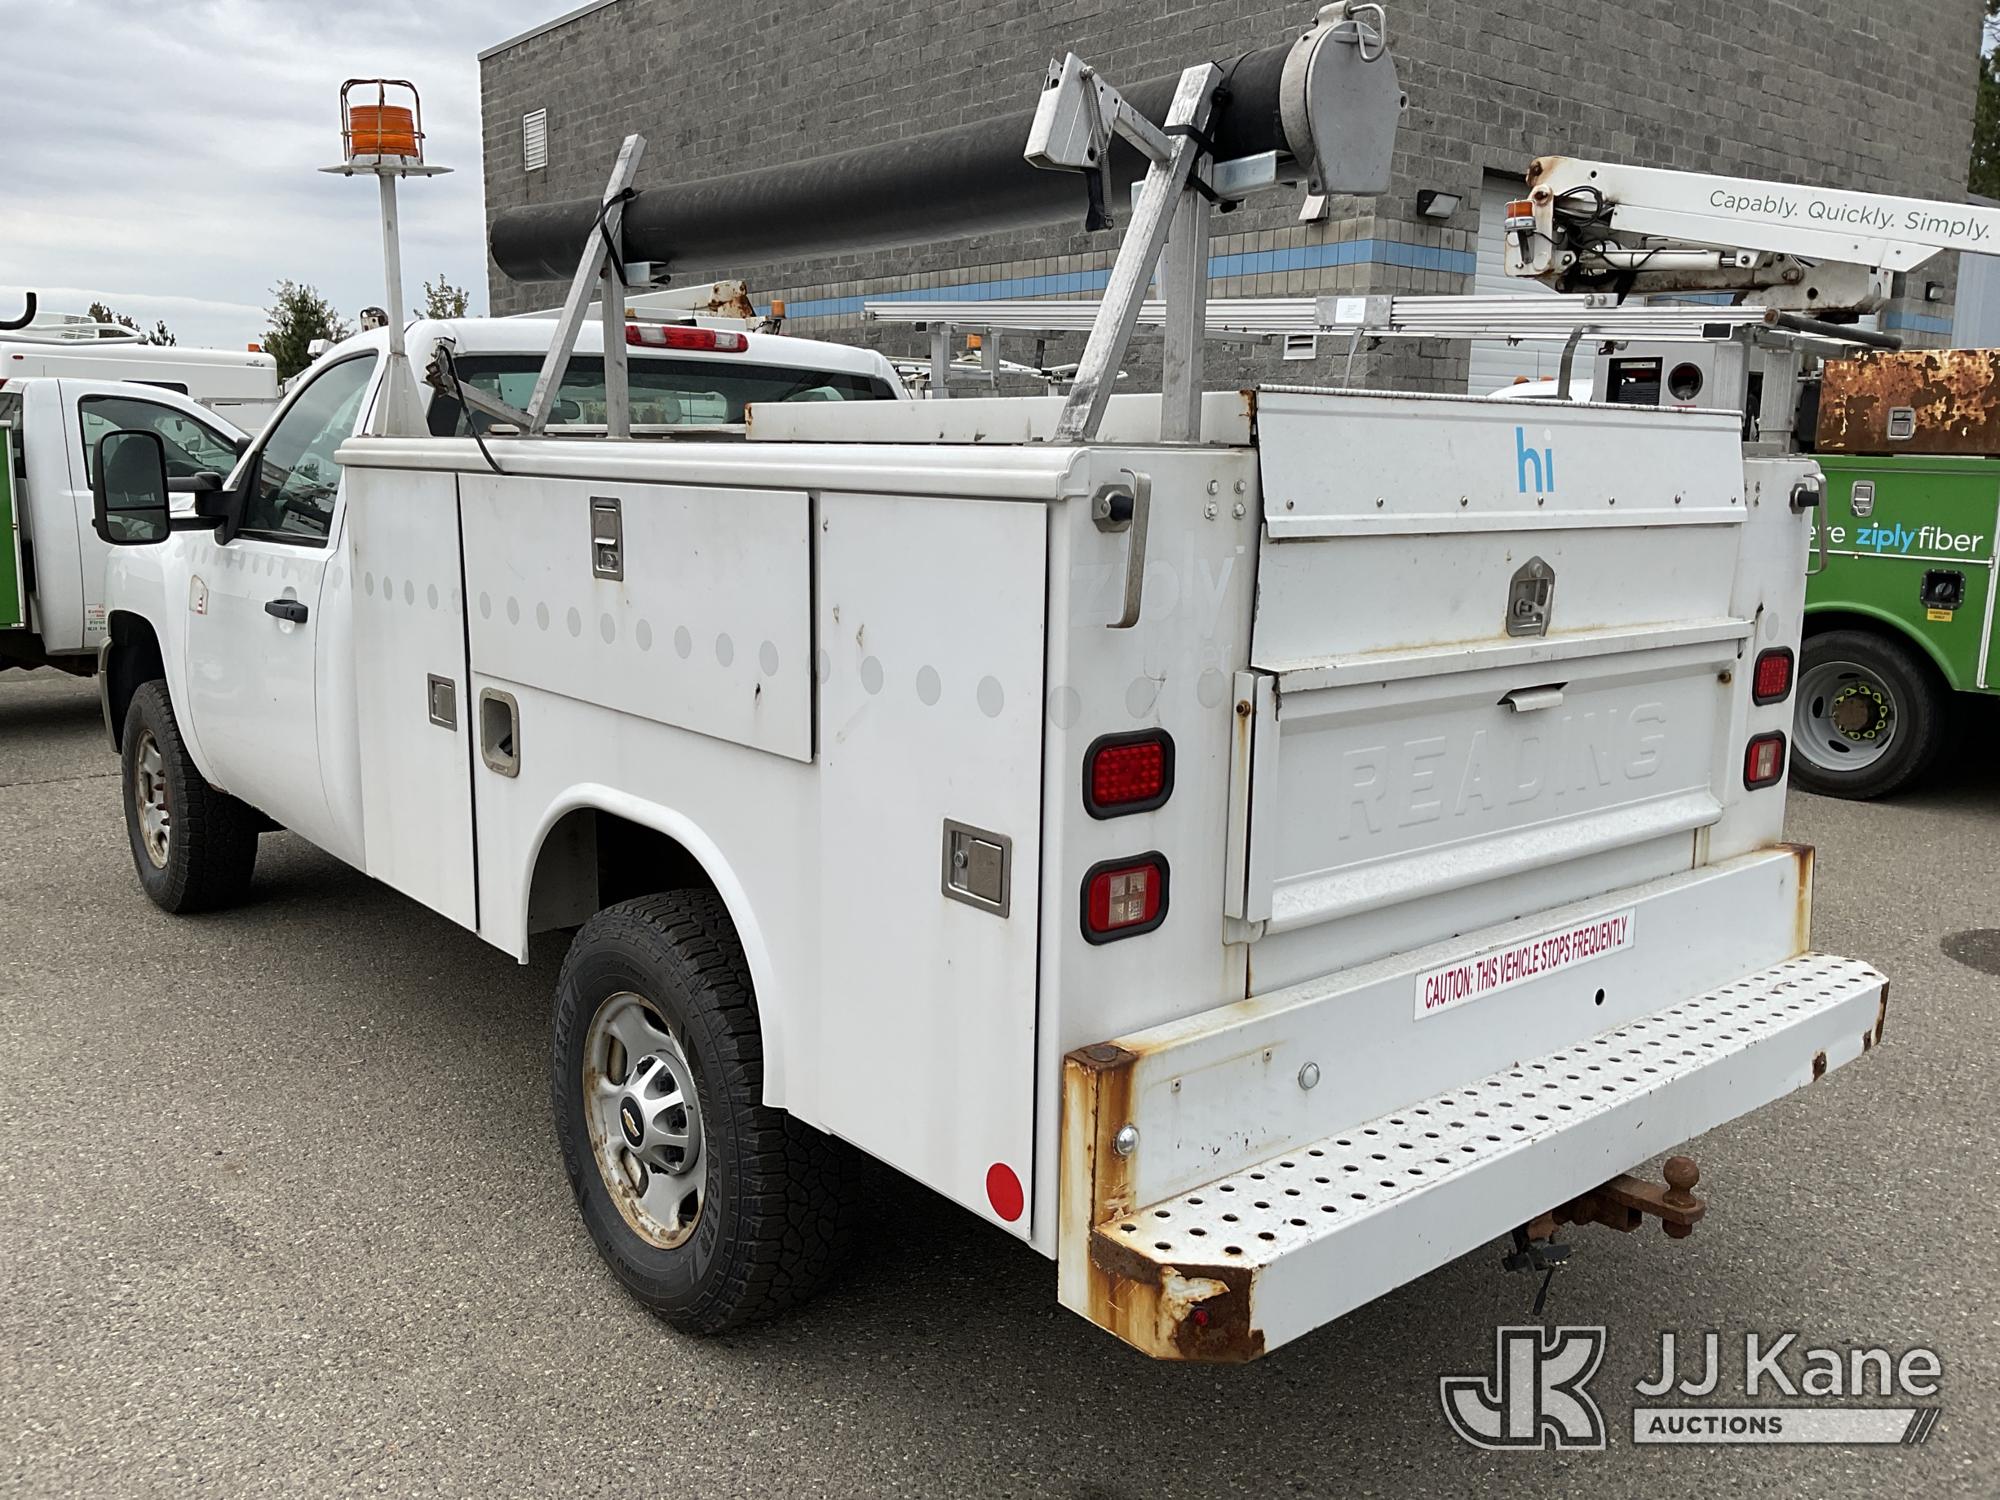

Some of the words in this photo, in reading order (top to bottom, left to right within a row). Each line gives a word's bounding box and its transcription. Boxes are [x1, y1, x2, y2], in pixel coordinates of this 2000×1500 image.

[1709, 190, 1798, 218] Capably.
[1808, 201, 1895, 230] Quickly.
[1904, 211, 1990, 241] Simply.
[1516, 427, 1554, 493] hi
[1856, 522, 1915, 553] ziply
[1919, 526, 1984, 552] fiber
[1339, 702, 1666, 840] READING
[1425, 967, 1474, 1009] CAUTION:
[1476, 957, 1498, 992] THIS
[1500, 944, 1539, 984] VEHICLE
[1541, 934, 1571, 971] STOPS
[1571, 915, 1628, 960] FREQUENTLY
